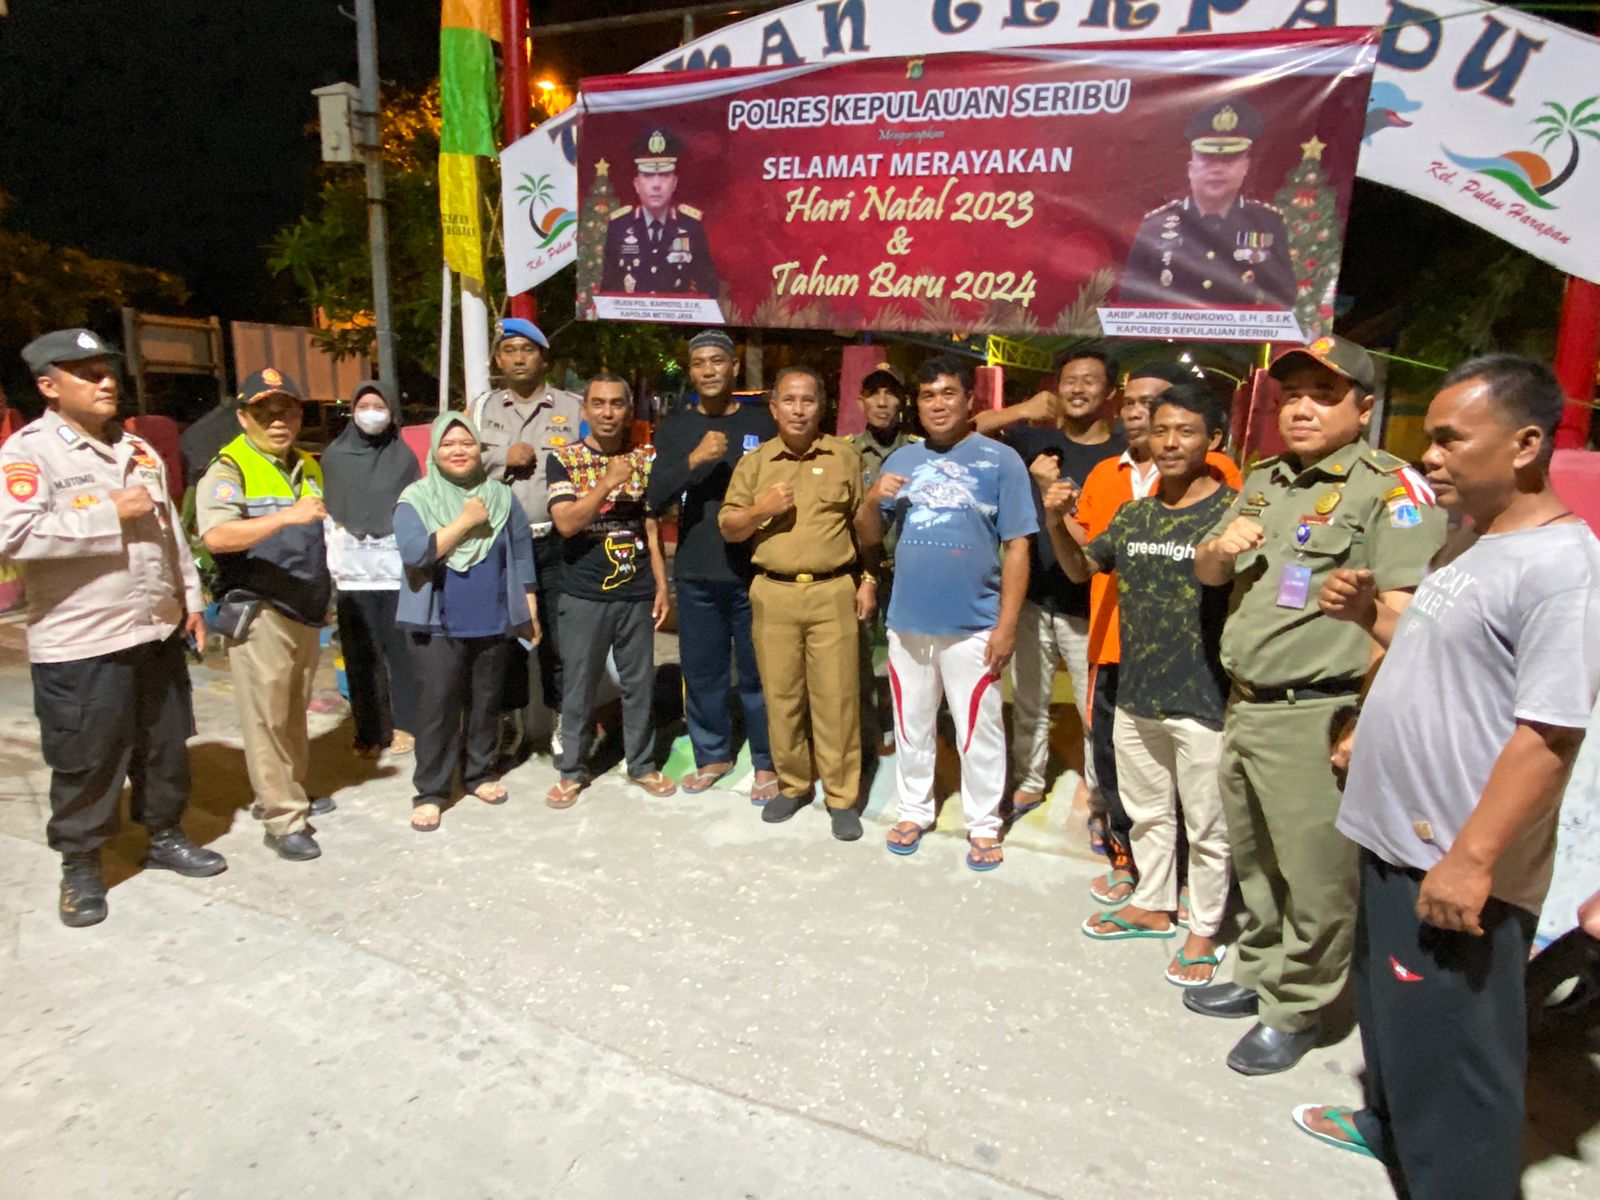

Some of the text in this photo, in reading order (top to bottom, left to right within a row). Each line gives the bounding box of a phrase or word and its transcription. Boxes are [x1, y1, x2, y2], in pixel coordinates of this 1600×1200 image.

[729, 78, 1130, 130] POLRES KEPULAUAN SERIBU
[762, 147, 1073, 180] SELAMAT MERAYAKAN
[785, 176, 1035, 229] Hari Natal 2023
[1459, 178, 1506, 211] Pulau
[1507, 201, 1572, 245] Harapan
[886, 225, 914, 255] &
[772, 255, 1038, 308] Tahun Baru 2024
[1107, 310, 1134, 320] AKBP
[1136, 311, 1169, 321] JAROT
[1116, 325, 1279, 338] KAPOLRES KEPULAUAN SERIBU
[545, 425, 572, 433] POLRI
